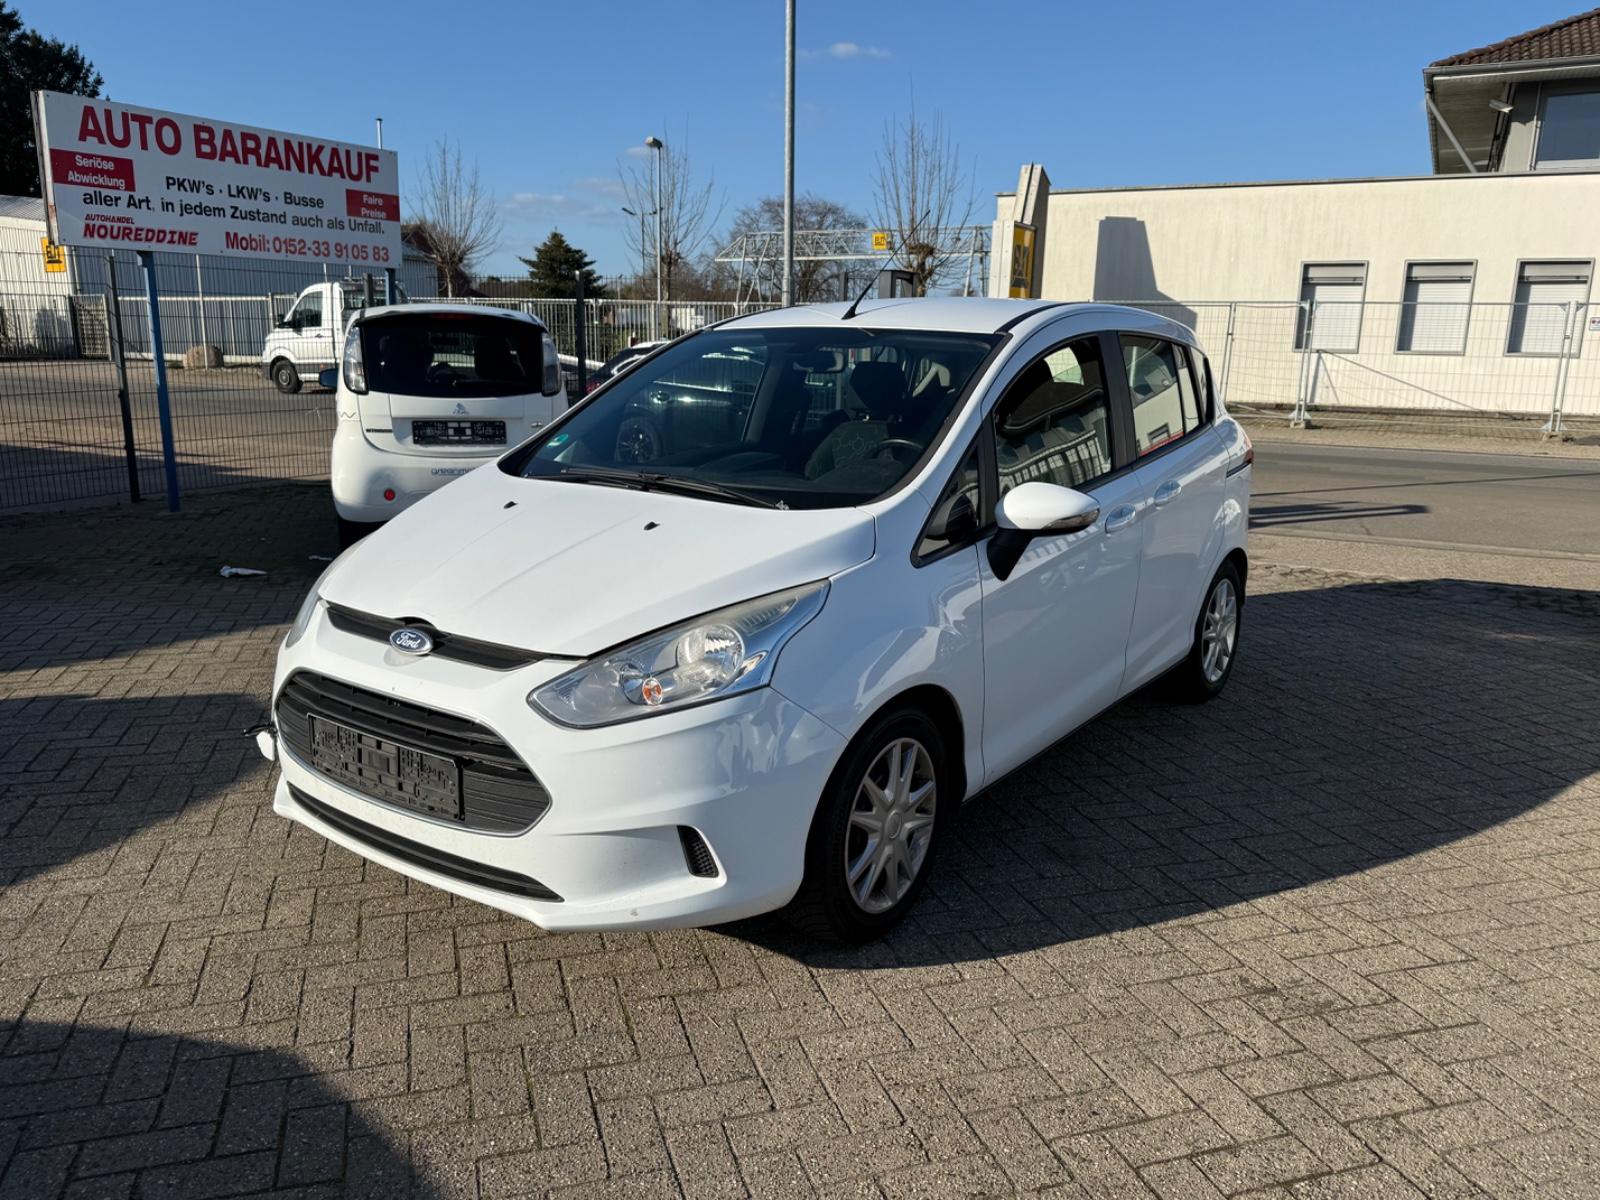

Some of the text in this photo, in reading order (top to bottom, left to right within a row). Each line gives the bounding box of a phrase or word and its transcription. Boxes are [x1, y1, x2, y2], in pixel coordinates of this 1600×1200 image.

[78, 105, 380, 183] AUTO BARANKAUF
[75, 155, 114, 170] Seriöse
[67, 170, 126, 189] Abwicklung
[283, 192, 325, 209] Busse
[363, 194, 383, 206] Faire
[83, 189, 121, 208] aller
[161, 197, 175, 213] in
[179, 199, 226, 218] jedem
[230, 206, 287, 225] Zustand
[291, 215, 323, 228] auch
[327, 217, 345, 230] als
[348, 219, 385, 234] Unfall.
[84, 213, 135, 225] AUTOHANDEL
[361, 208, 387, 219] Preise
[83, 223, 199, 246] NOUREDDINE
[225, 231, 270, 253] Mobil:
[372, 247, 389, 262] 83
[396, 632, 421, 649] Ford
